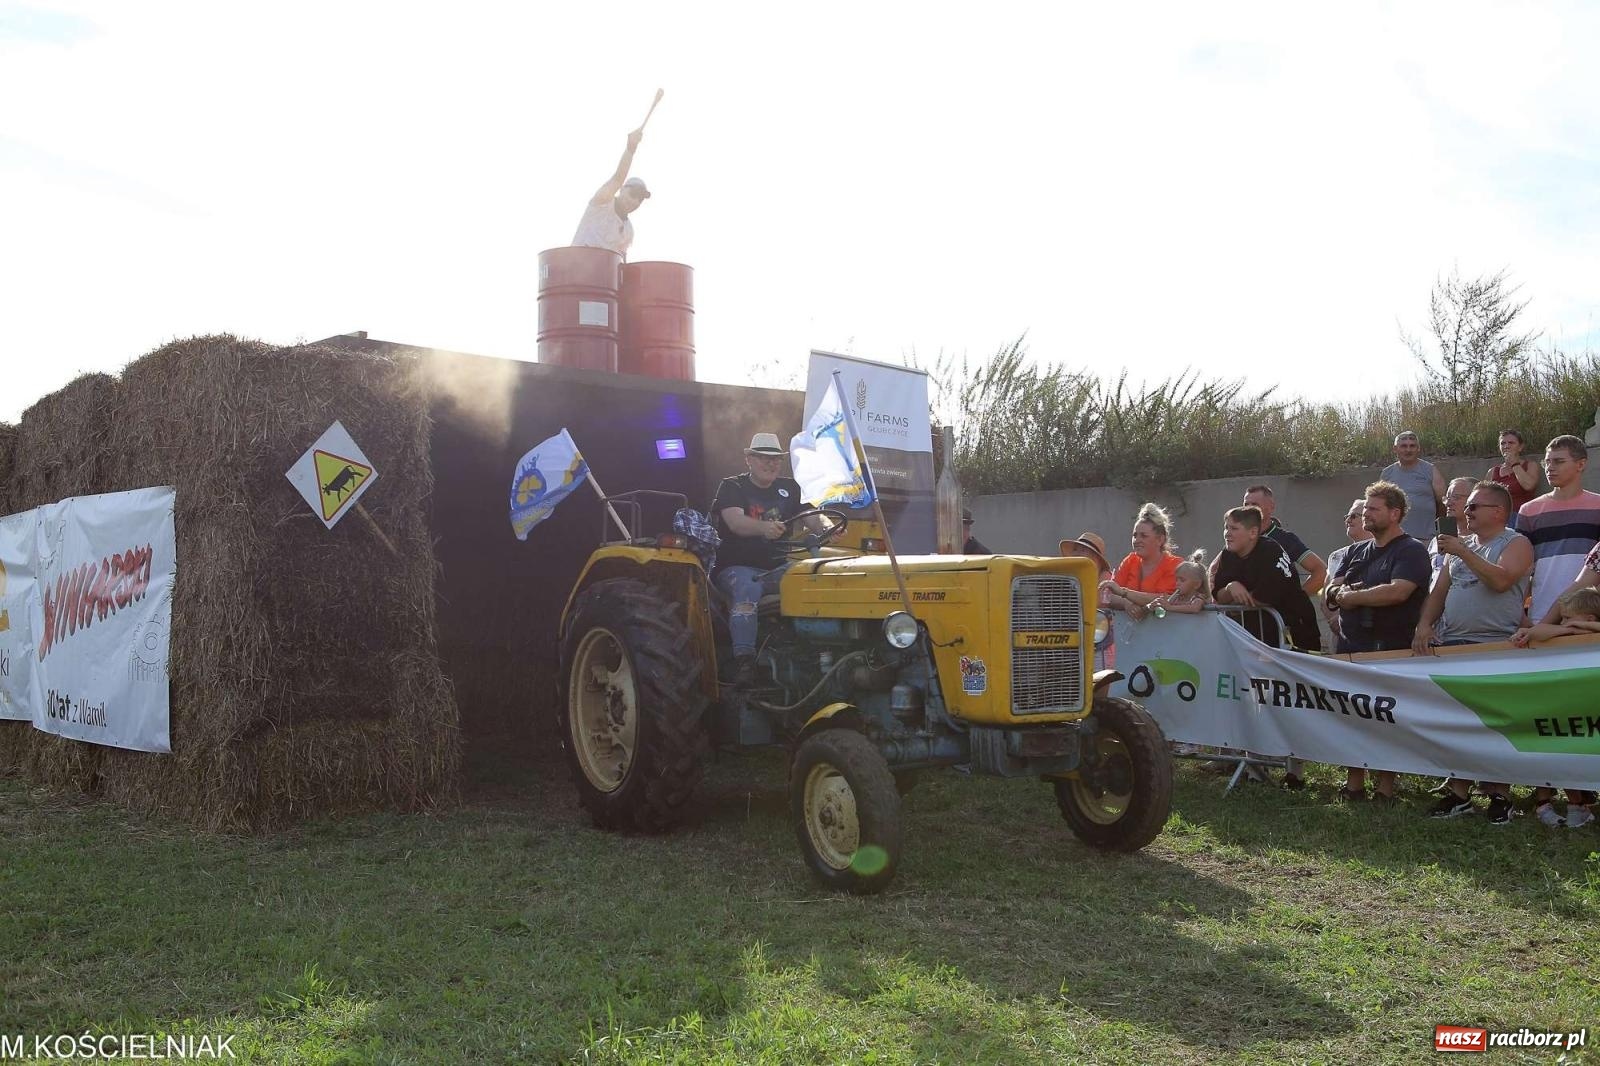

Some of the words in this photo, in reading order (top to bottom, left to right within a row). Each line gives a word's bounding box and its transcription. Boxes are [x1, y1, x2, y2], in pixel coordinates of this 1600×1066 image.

[867, 412, 909, 428] FARMS
[878, 592, 902, 601] SAFET
[912, 592, 946, 601] TRAKTOR
[1026, 634, 1070, 645] TRAKTOR
[1216, 673, 1397, 724] EL-TRAKTOR
